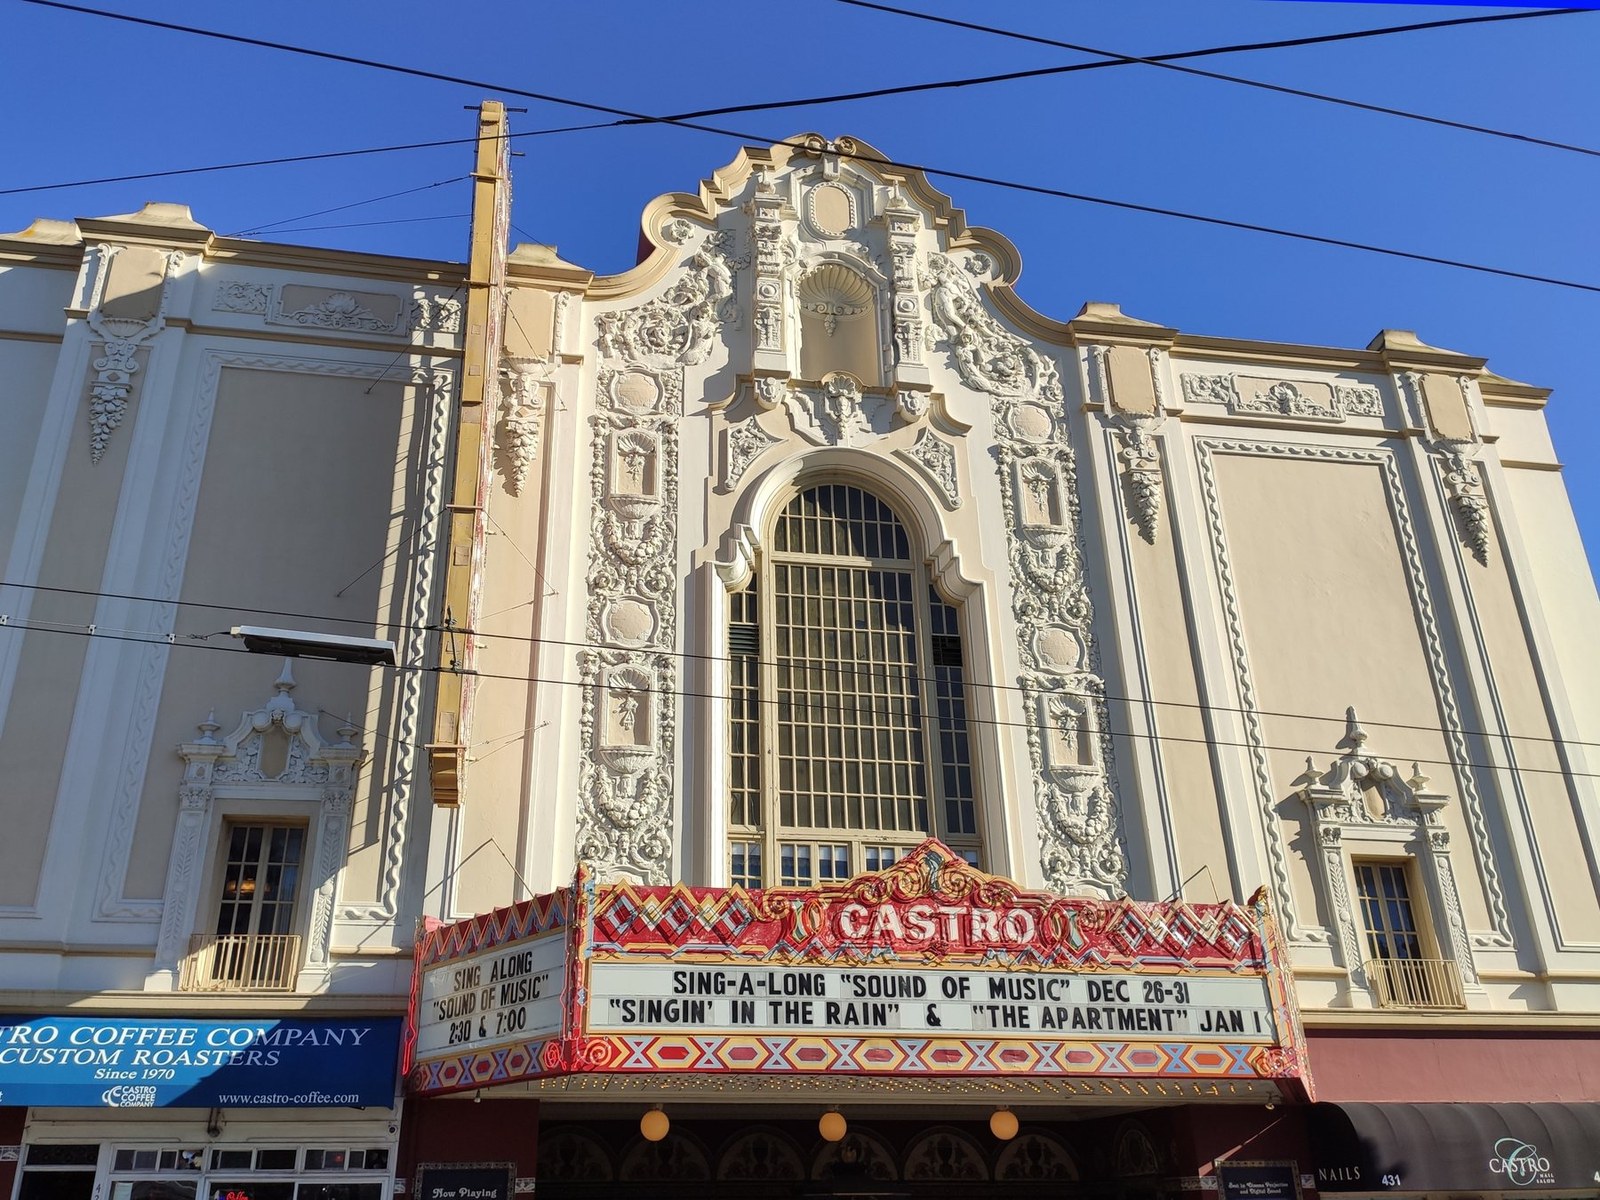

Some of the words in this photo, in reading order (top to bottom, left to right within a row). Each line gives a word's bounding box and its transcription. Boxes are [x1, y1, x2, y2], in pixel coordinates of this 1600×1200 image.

[840, 904, 1036, 944] CASTRO
[453, 965, 481, 992] SING
[490, 951, 533, 982] ALONG
[673, 971, 826, 997] SING-A-LONG
[840, 974, 927, 998] "SOUND
[942, 976, 970, 999] OF
[989, 977, 1070, 1002] MUSIC"
[1088, 980, 1130, 1003] DEC
[1143, 981, 1190, 1004] 26-31
[433, 992, 475, 1021] "SOUND
[480, 987, 496, 1011] OF
[500, 974, 549, 1007] MUSIC"
[610, 999, 713, 1024] "SINGIN'
[732, 1000, 755, 1024] IN
[769, 1002, 813, 1025] THE
[826, 1002, 900, 1026] RAIN"
[926, 1003, 942, 1027] &
[973, 1005, 1030, 1029] "THE
[1041, 1006, 1188, 1032] APARTMENT"
[1200, 1009, 1244, 1033] JAN
[448, 1019, 471, 1044] 2:30
[478, 1015, 487, 1038] &
[496, 1007, 526, 1035] 7:00
[69, 1026, 198, 1046] COFFEE
[207, 1027, 372, 1047] COMPANY
[0, 1047, 124, 1065] CUSTOM
[131, 1049, 281, 1066] ROASTERS
[94, 1068, 138, 1080] Since
[141, 1068, 175, 1080] 1970
[121, 1093, 156, 1102] COFFEE
[122, 1085, 157, 1094] CASTRO
[218, 1091, 359, 1104] www.castro-coffee.com
[1318, 1166, 1360, 1181] NAILS
[1489, 1157, 1550, 1173] CASTRO
[1381, 1174, 1401, 1186] 431
[432, 1187, 456, 1199] Now
[458, 1187, 498, 1199] Playing
